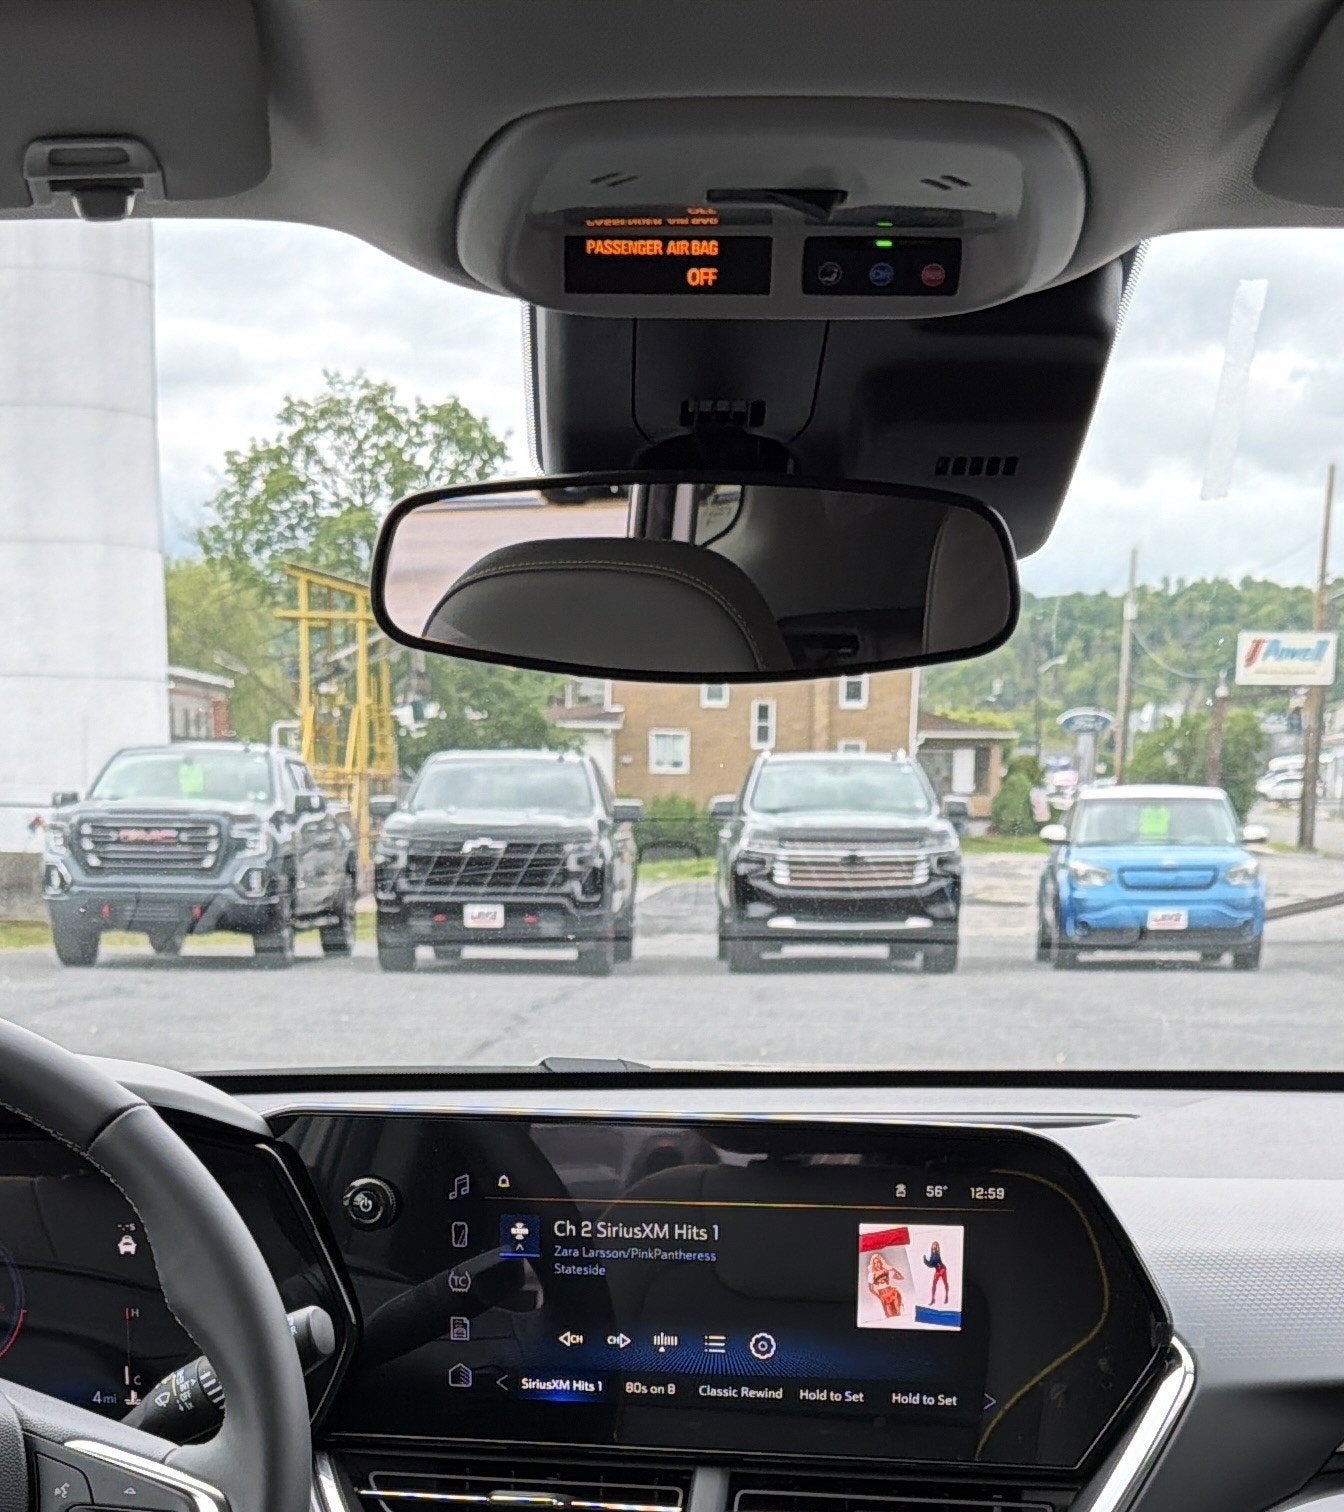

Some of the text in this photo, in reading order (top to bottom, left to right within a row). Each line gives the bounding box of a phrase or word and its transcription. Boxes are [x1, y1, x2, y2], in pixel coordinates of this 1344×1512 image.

[585, 240, 663, 256] PASSENGER
[687, 268, 718, 287] OFF
[926, 1185, 1005, 1200] 56° 12:59
[554, 1221, 719, 1241] Ch 2 SiriusXM Hits 1
[554, 1246, 717, 1262] Zara Larsson/PinkPantheress
[554, 1263, 606, 1276] Stateside
[131, 1309, 140, 1318] H
[571, 1334, 584, 1344] CH
[133, 1375, 141, 1386] C
[522, 1378, 603, 1392] SiriusXM Hits 1
[625, 1382, 648, 1394] 80s
[651, 1385, 665, 1394] on
[699, 1384, 783, 1399] Classic Rewind
[800, 1389, 864, 1402] Hold to Set
[892, 1393, 957, 1406] Hold to Set
